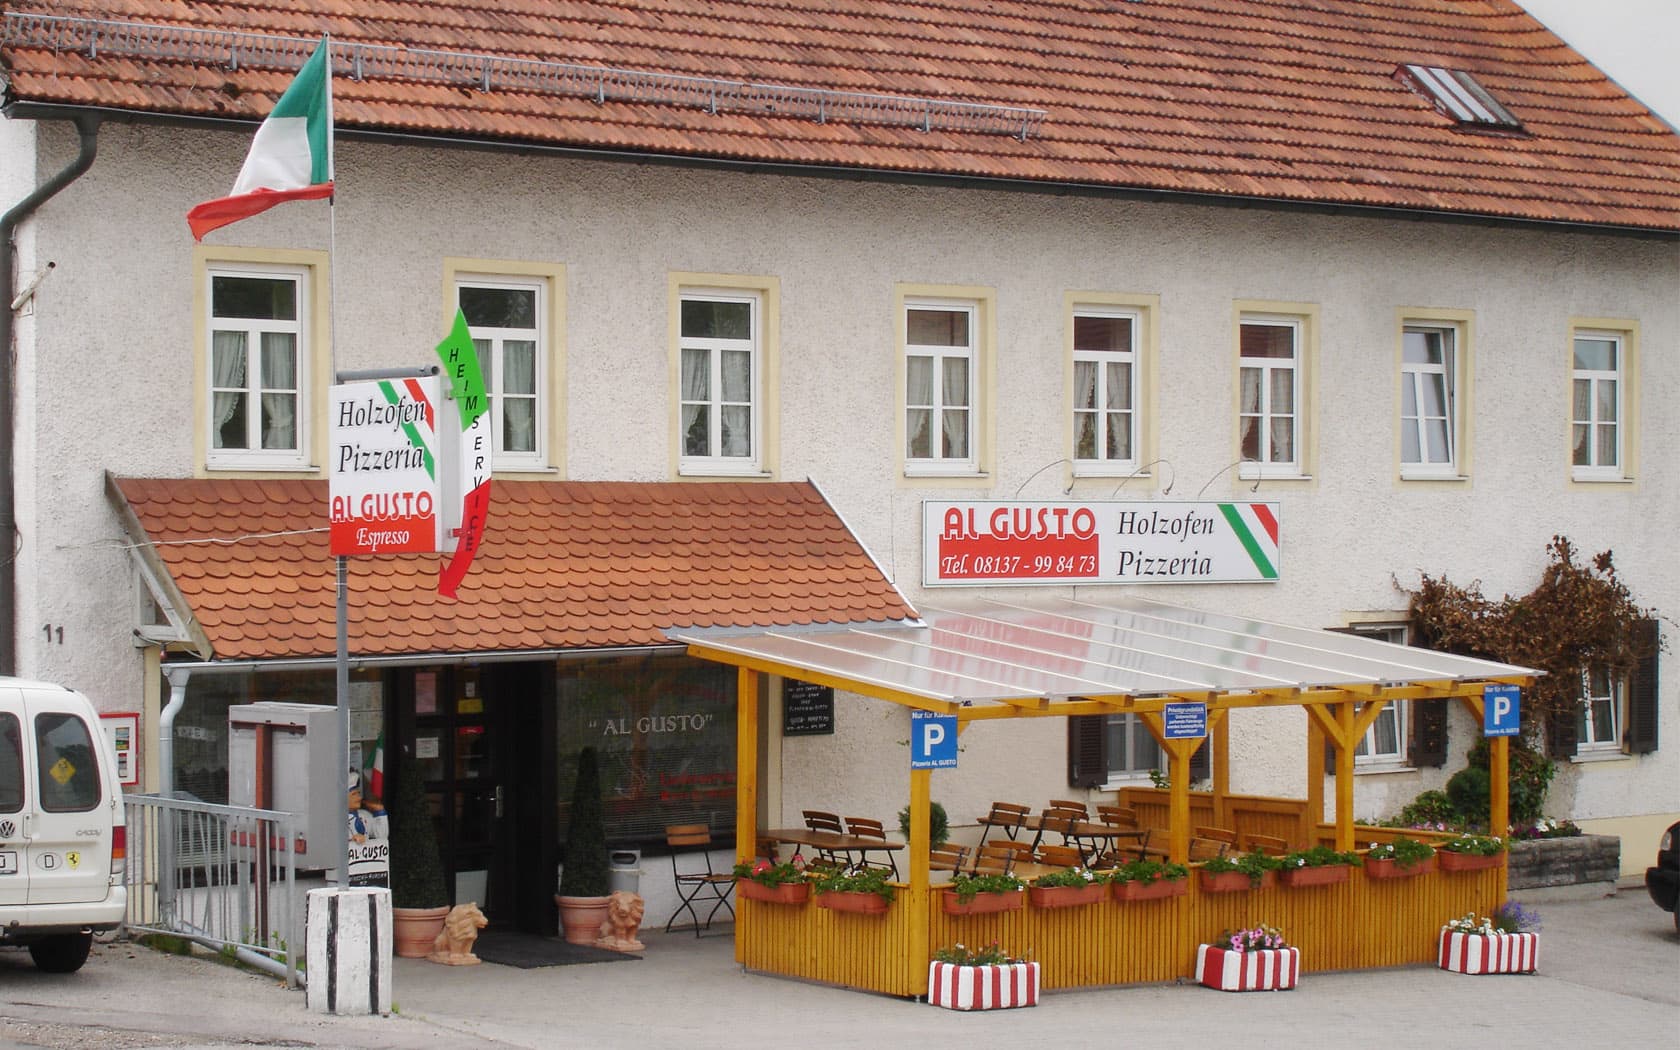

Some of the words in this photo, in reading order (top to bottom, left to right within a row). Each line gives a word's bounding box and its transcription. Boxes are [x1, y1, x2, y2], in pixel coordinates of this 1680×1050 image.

[338, 396, 425, 432] Holzofen
[338, 441, 424, 472] Pizzeria
[332, 495, 354, 523] AL
[360, 490, 433, 522] GUSTO
[943, 507, 979, 540] AL
[989, 507, 1096, 540] GUSTO
[1117, 510, 1214, 542] Holzofen
[356, 527, 410, 551] Espresso
[941, 554, 969, 574] Tel.
[974, 555, 1021, 574] 08137
[1033, 555, 1053, 574] 99
[1056, 555, 1074, 573] 84
[1078, 555, 1096, 573] 73
[1117, 550, 1213, 576] Pizzeria
[43, 623, 64, 644] 11
[1494, 696, 1510, 725] P
[604, 719, 631, 736] AL
[924, 723, 945, 756] P
[44, 854, 54, 868] D
